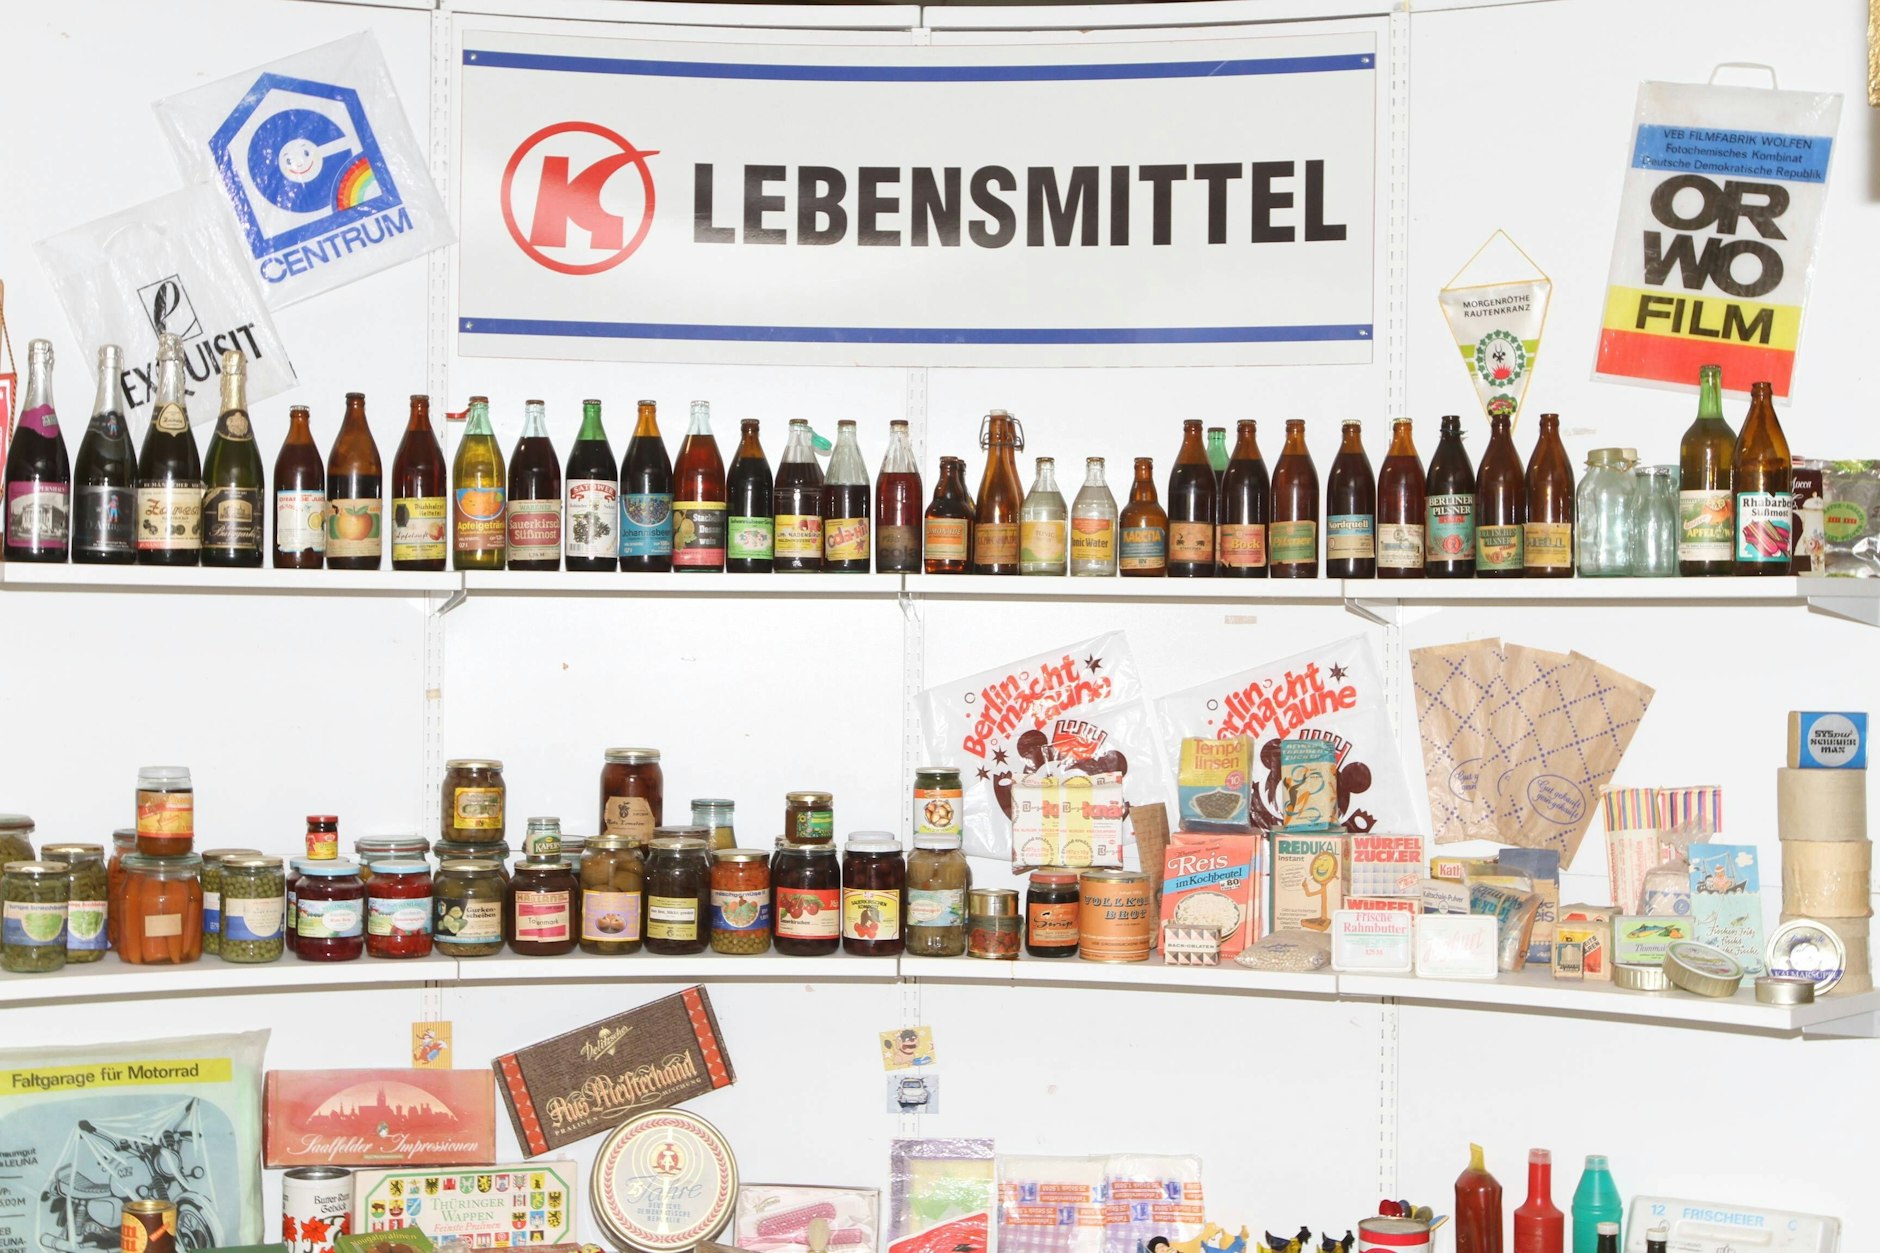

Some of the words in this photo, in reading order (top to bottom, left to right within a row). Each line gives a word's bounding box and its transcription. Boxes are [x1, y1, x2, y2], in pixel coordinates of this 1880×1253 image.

[1664, 130, 1684, 140] VEB
[1689, 131, 1756, 145] FILMFABRIK
[1762, 136, 1812, 150] WOLFEN
[1665, 144, 1747, 159] Fotochemisches
[1752, 150, 1802, 164] Kombinat
[1642, 156, 1691, 170] Deutsche
[1694, 160, 1772, 176] Demokratische
[1775, 166, 1821, 179] Republik
[693, 159, 1347, 248] LEBENSMITTEL
[260, 206, 413, 284] CENTRUM
[1463, 294, 1530, 309] MORGENRÖTHE
[1464, 304, 1530, 318] RAUTENKRANZ
[1635, 294, 1775, 344] FILM
[1429, 496, 1473, 505] BERLINER
[1432, 506, 1471, 515] PILSNER
[1328, 519, 1369, 529] Nordquell
[1085, 539, 1108, 549] Water
[1231, 538, 1261, 549] Bock
[996, 654, 1080, 740] macht
[1240, 662, 1325, 741] macht
[963, 673, 1021, 759] Berlin
[1273, 685, 1358, 740] Laune
[1195, 755, 1239, 770] linsen
[1230, 775, 1240, 785] 10
[1278, 840, 1339, 855] REDUKAL
[1354, 836, 1421, 850] WÜRFEL
[1168, 852, 1228, 876] Reis
[1354, 850, 1420, 863] ZUCKER
[1084, 896, 1150, 906] VOLLKO
[1104, 909, 1147, 920] BROT
[1355, 912, 1393, 922] Frische
[1344, 922, 1407, 934] Rahmbutter
[12, 1069, 95, 1090] Faltgarage
[101, 1067, 123, 1081] für
[128, 1063, 199, 1080] Motorrad
[554, 1116, 599, 1136] PRALINEN
[661, 1077, 702, 1097] MISCHUNG
[286, 1133, 373, 1161] Saalfelder
[380, 1133, 478, 1159] Impressionen
[4, 1157, 39, 1167] LEUNA
[626, 1175, 702, 1204] Jahre
[431, 1198, 505, 1210] THÜRINGER
[441, 1211, 494, 1222] WAPPEN
[1650, 1204, 1666, 1216] 12
[1682, 1207, 1764, 1227] FRISCHEIER
[0, 1237, 27, 1246] EUNA-
